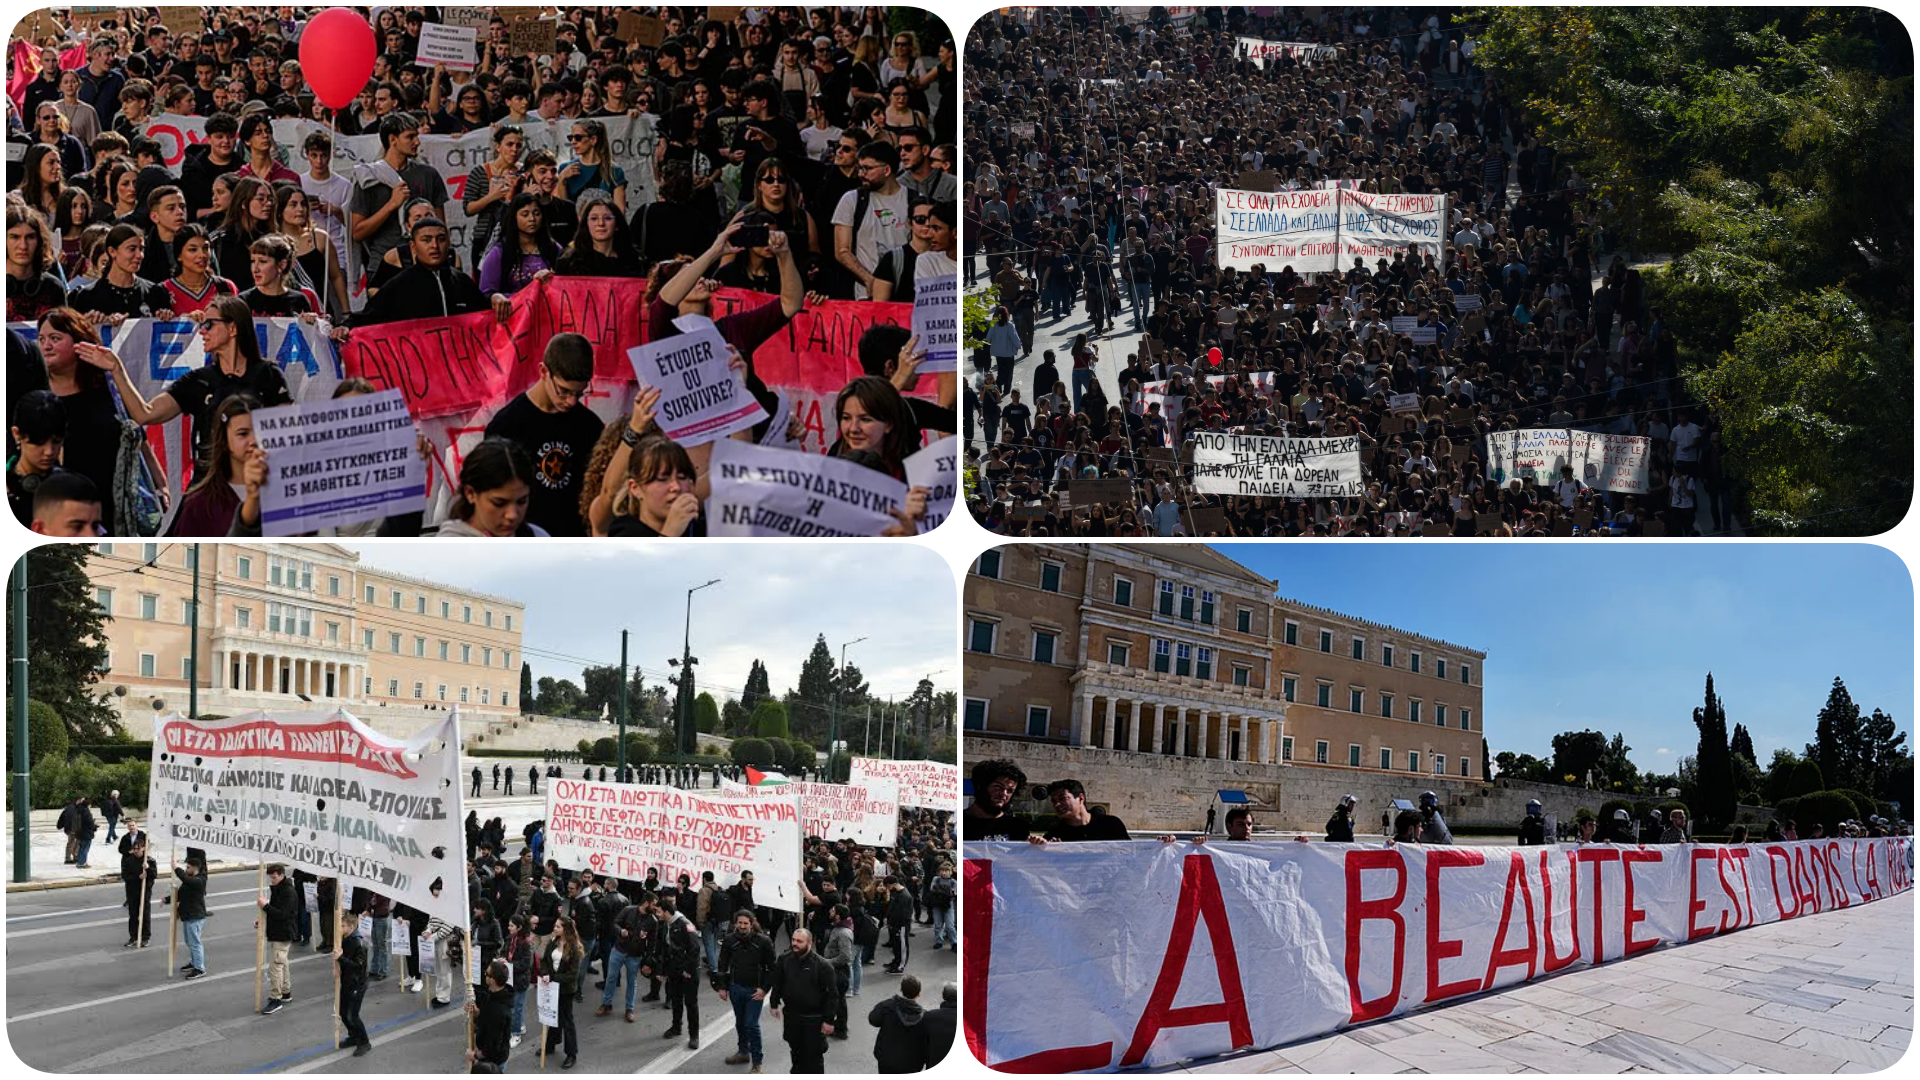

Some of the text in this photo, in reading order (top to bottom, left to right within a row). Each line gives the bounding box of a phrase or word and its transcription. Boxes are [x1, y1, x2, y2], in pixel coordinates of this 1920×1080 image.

[1226, 192, 1244, 209] ΣΕ
[1248, 193, 1270, 210] ΟΛΑ
[1274, 194, 1290, 210] ΤΑ
[1290, 192, 1330, 209] ΣΧΟΛΕΙΑ
[1230, 212, 1440, 238] ΣΕ ΕΛΛΑΔΑ ΚΑΙ ΓΑΛΛΙΑ ΙΔΙΟΣ Ο ΕΧΘΡΟΣ
[1232, 244, 1296, 258] ΣΥΝΤΟΝΙΣΤΙΚΗ
[1300, 242, 1343, 256] ΕΠΙΤΡΟΠΗ
[1348, 244, 1392, 257] ΜΑΘΗΤΩΝ
[925, 319, 957, 330] ΚΑΜΙΑ
[928, 334, 936, 345] 15
[655, 341, 714, 377] ÉTUDIER
[682, 368, 703, 390] OU
[663, 379, 734, 422] SURVIVRE?
[260, 417, 278, 431] ΝΑ
[280, 408, 348, 429] ΚΑΛΥΦΘΟΥΝ
[351, 404, 372, 418] ΕΔΩ
[374, 401, 392, 414] ΚΑΙ
[262, 436, 286, 450] ΟΛΑ
[288, 434, 304, 446] ΤΑ
[306, 430, 334, 445] ΚΕΝΑ
[1194, 433, 1224, 450] ΑΠΟ
[1230, 436, 1257, 453] ΤΗΝ
[1261, 438, 1317, 454] ΕΛΛΑΔΑ
[1489, 432, 1506, 443] ΑΠΟ
[1533, 431, 1570, 440] ΕΛΛΑΔΑ
[1232, 453, 1306, 468] ΤΗ ΓΑΛΛΙΑ
[1602, 445, 1648, 457] AVEC LES
[280, 447, 408, 480] ΚΑΜΙΑ ΣΥΓΧΩΝΕΥΣΗ
[1513, 458, 1545, 468] ΠΑΙΔΕΙΑ
[1617, 467, 1632, 476] DU
[284, 483, 297, 498] 15
[300, 473, 361, 495] ΜΑΘΗΤΕΣ
[374, 466, 406, 483] ΤΑΞΗ
[1270, 467, 1288, 480] ΓΙΑ
[1294, 468, 1339, 482] ΔΩΡΕΑΝ
[1610, 478, 1643, 490] MONDE
[1239, 481, 1296, 494] ΠΑΙΔΕΙΑ
[1324, 485, 1345, 496] ΓΕΛ
[722, 504, 752, 525] ΝΑ
[851, 758, 878, 771] ΟΧΙ
[368, 788, 446, 820] ΣΠΟΥΔΕΣ
[556, 780, 586, 800] ΟΧΙ
[588, 787, 616, 804] ΣΤΑ
[621, 790, 682, 810] ΙΔΙΩΤΙΚΑ
[206, 799, 238, 816] ΑΞΙΑ
[553, 803, 596, 820] ΔΩΣΤΕ
[600, 808, 646, 826] ΛΕΦΤΑ
[650, 812, 670, 829] ΓΙΑ
[177, 822, 250, 849] ΦΟΙΤΗΤΙΚΟΙ
[628, 844, 661, 858] ΕΣΤΙΑ
[963, 854, 1254, 1074] LA
[1688, 847, 1754, 941] EST
[1766, 842, 1850, 921] DANS
[1852, 840, 1882, 902] LA
